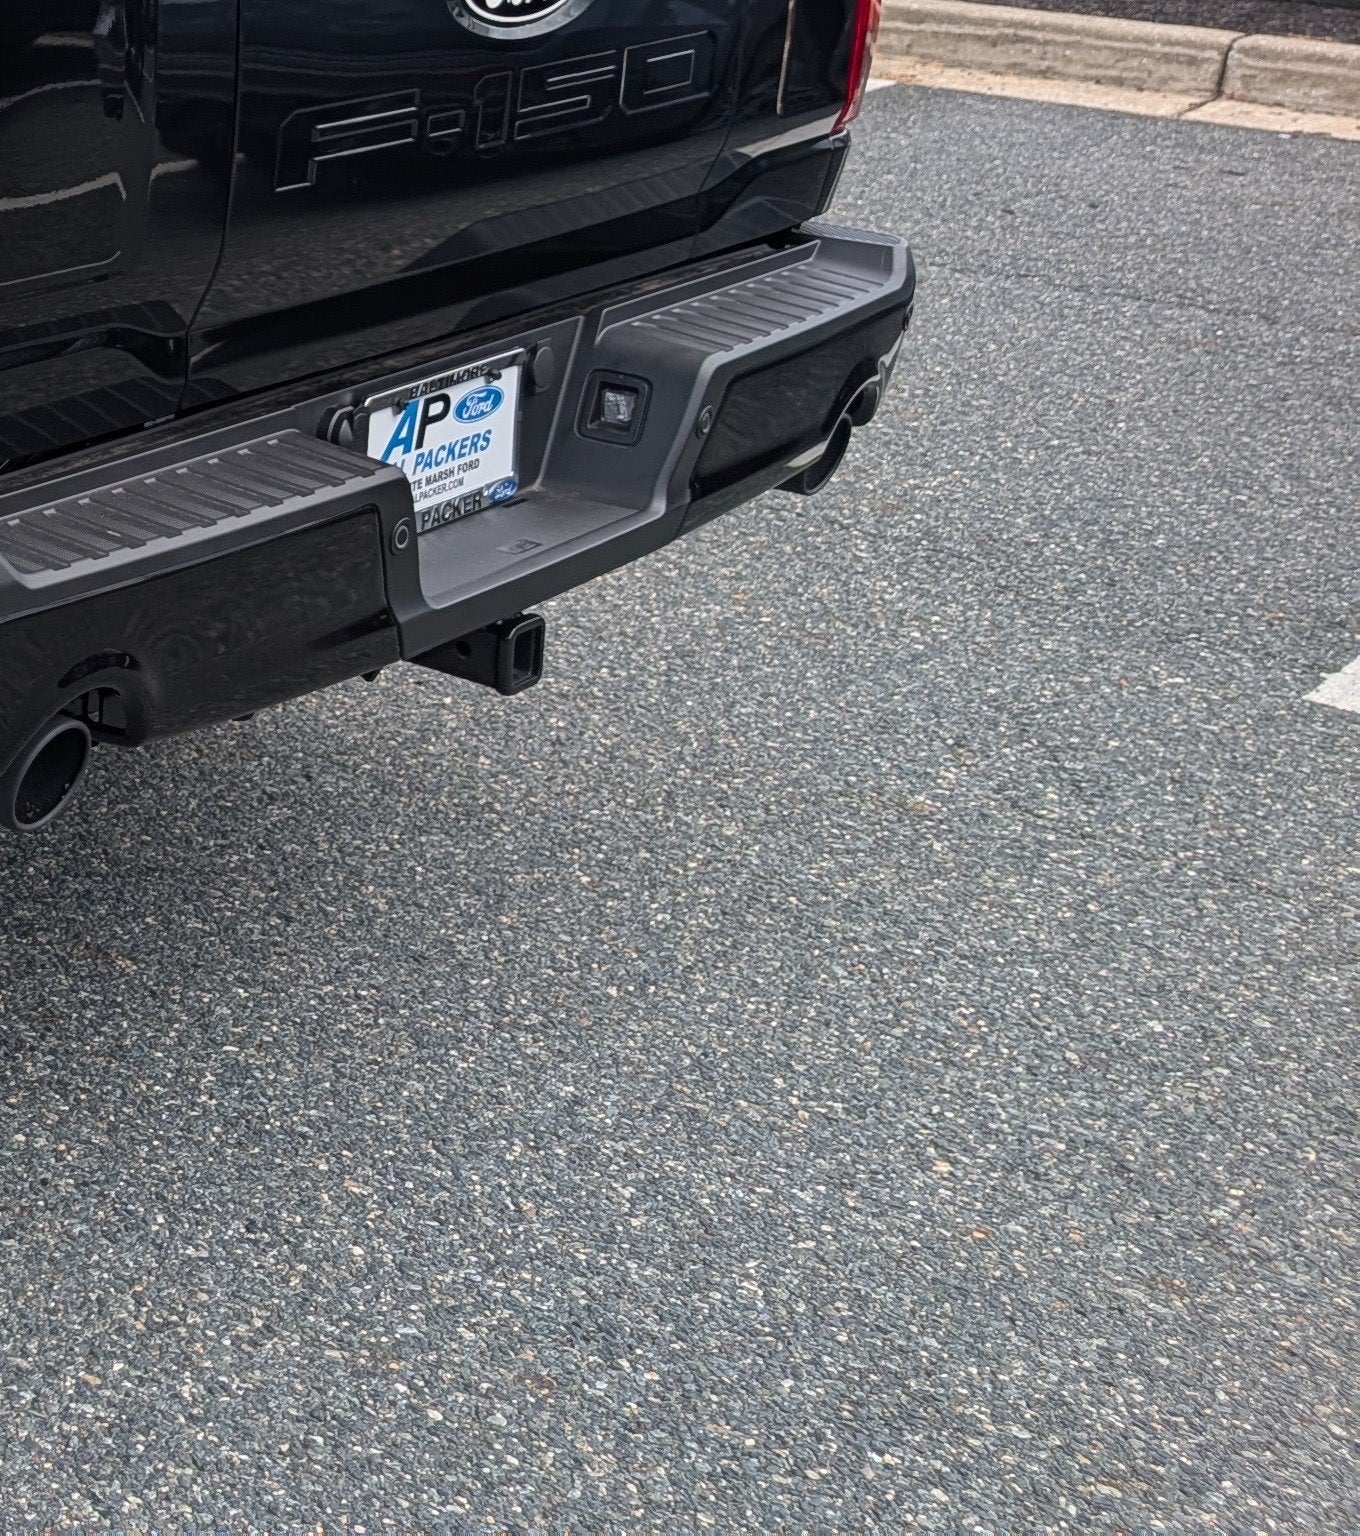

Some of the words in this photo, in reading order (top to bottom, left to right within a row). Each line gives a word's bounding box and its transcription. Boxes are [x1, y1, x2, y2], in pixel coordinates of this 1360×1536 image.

[274, 28, 718, 192] F-150
[412, 429, 492, 475] PACKERS
[425, 466, 455, 486] MARSH
[457, 458, 480, 475] FORD
[414, 476, 464, 503] LPACKER.COM
[420, 490, 482, 530] PACKER
